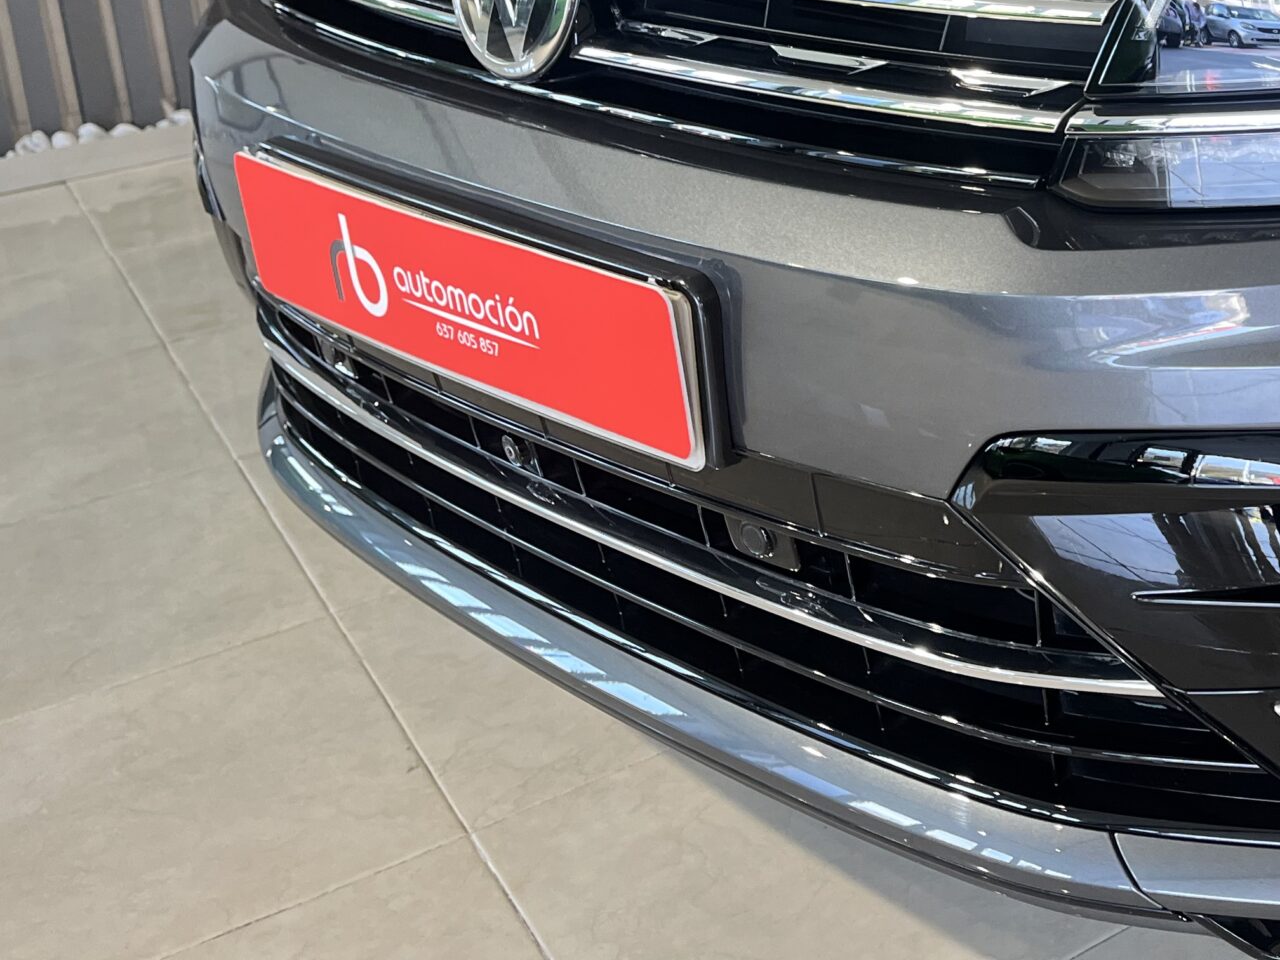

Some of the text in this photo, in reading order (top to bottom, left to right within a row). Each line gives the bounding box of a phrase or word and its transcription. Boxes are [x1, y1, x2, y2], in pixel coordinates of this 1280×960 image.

[393, 265, 540, 340] automoción
[435, 321, 499, 357] 637 605 857
